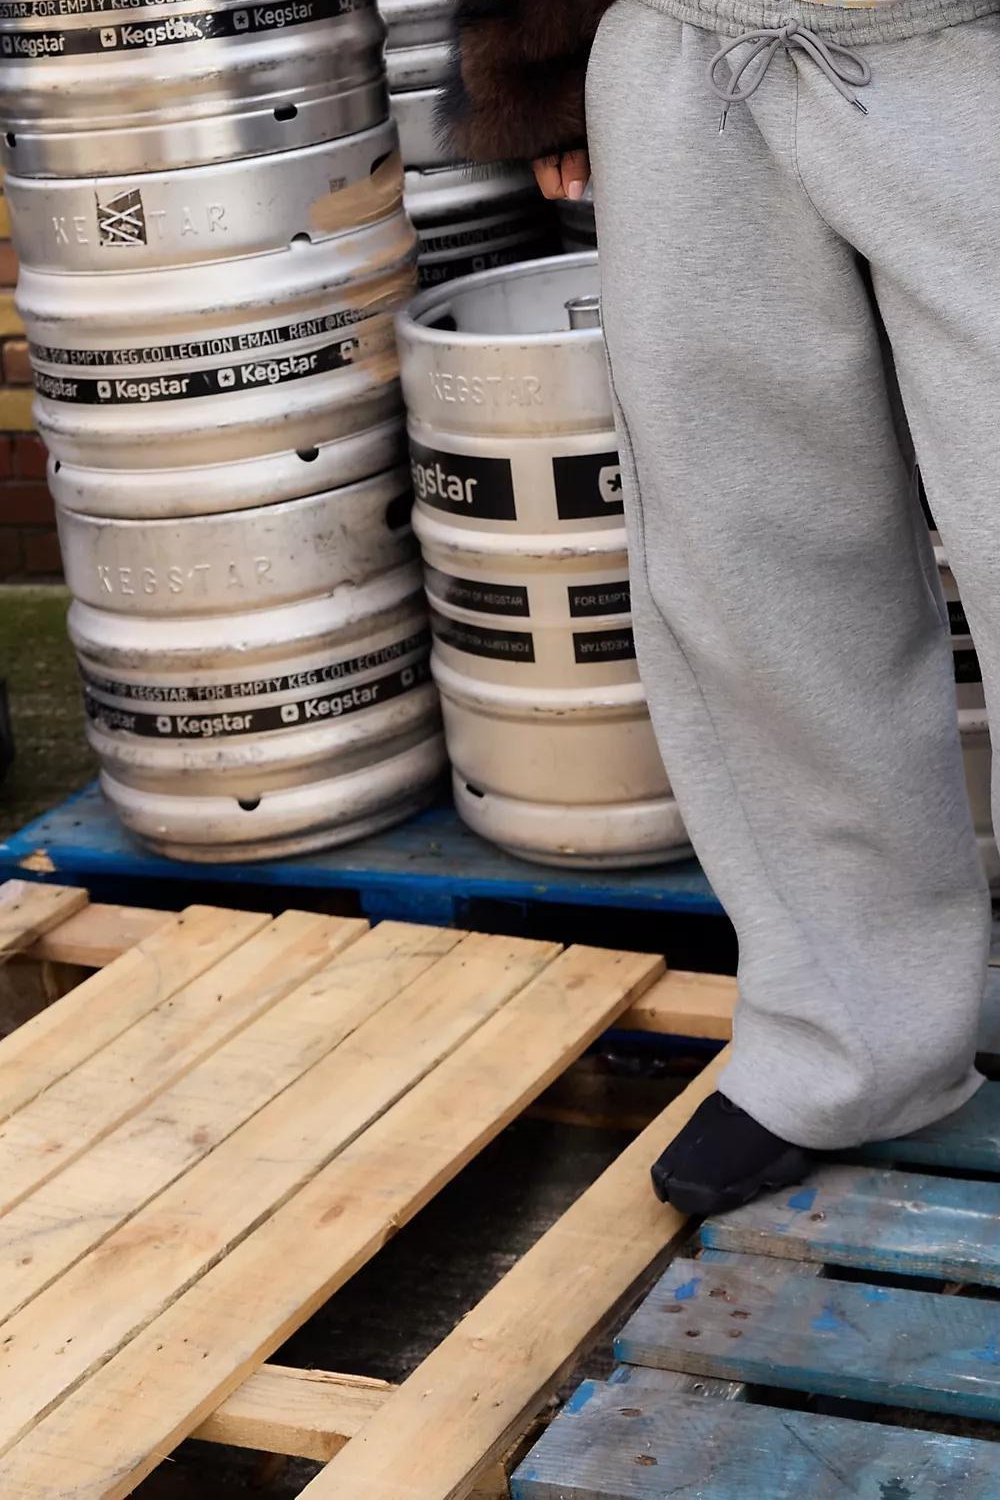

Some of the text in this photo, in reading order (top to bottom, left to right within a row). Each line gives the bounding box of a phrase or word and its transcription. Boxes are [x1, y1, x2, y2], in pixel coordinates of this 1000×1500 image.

[253, 2, 314, 28] Kegstar
[112, 349, 139, 364] KEG
[143, 338, 233, 363] COLLECTION
[239, 329, 285, 350] EMAIL
[115, 377, 190, 402] Kegstar
[240, 353, 318, 384] Kegstar
[97, 555, 275, 596] KEGSTAR
[574, 595, 596, 607] FOR
[197, 686, 226, 702] FOR
[230, 678, 284, 698] EMPTY
[288, 670, 318, 687] KEG
[175, 713, 253, 738] Kegstar
[304, 684, 380, 719] Kegstar
